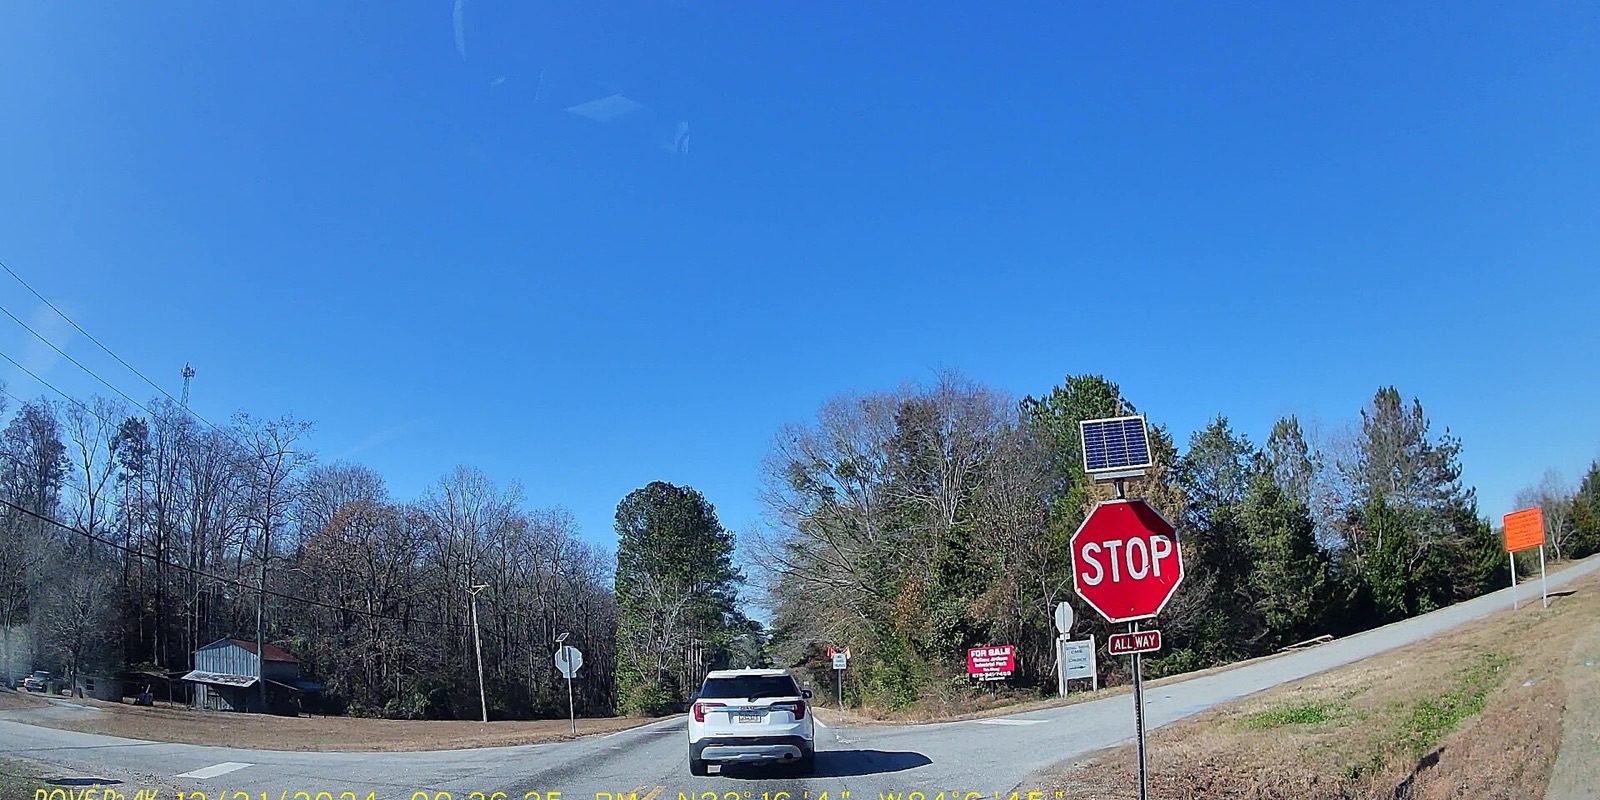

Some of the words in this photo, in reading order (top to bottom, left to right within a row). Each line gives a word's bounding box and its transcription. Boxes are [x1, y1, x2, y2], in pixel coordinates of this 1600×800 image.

[1081, 534, 1172, 586] STOP
[1114, 637, 1134, 651] ALL
[1134, 634, 1156, 650] WAY
[970, 649, 987, 658] FOR
[988, 647, 1011, 656] SALE
